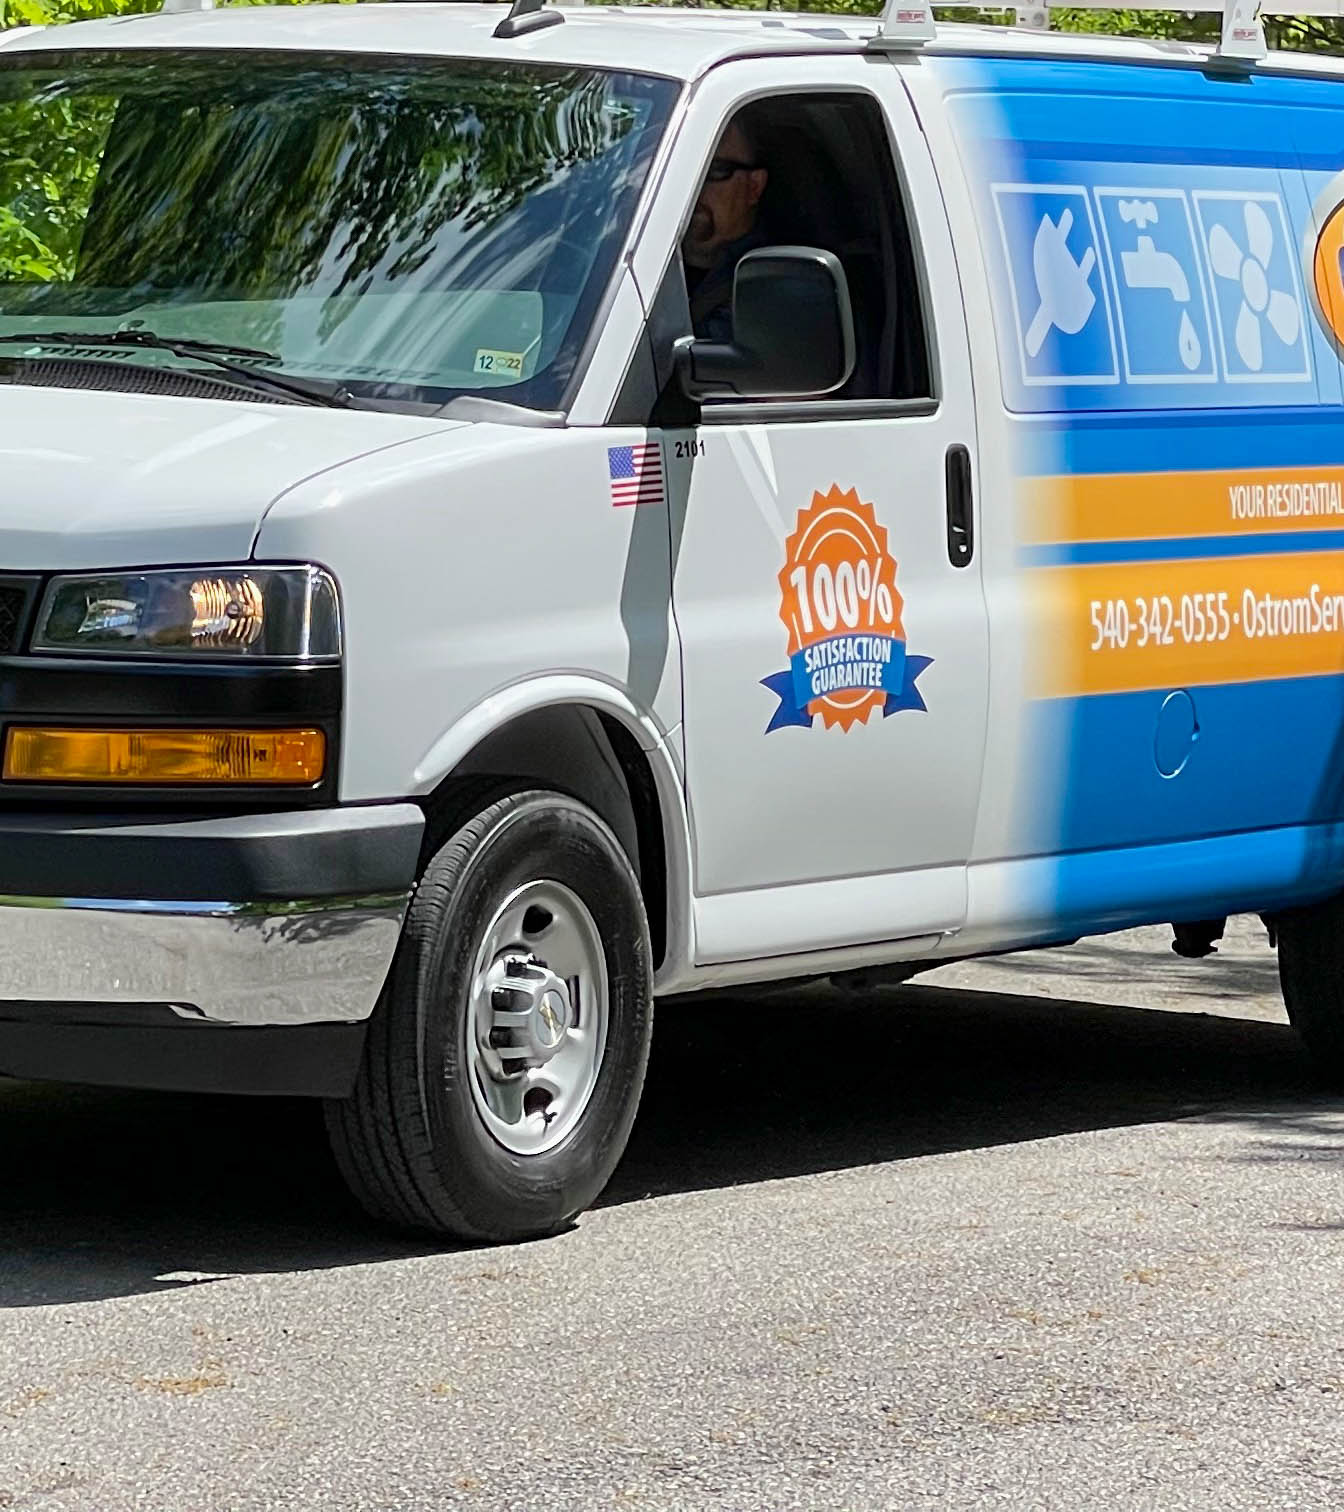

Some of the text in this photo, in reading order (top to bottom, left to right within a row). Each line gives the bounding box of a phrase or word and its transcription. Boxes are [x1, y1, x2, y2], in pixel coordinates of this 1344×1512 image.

[479, 355, 521, 369] 12 22
[675, 440, 705, 458] 2101
[1229, 485, 1264, 519] YOUR
[1267, 482, 1344, 517] RESIDENTIAL
[790, 557, 893, 632] 100%
[804, 637, 892, 673] SATISFACTION
[811, 663, 884, 695] GUARANTEE
